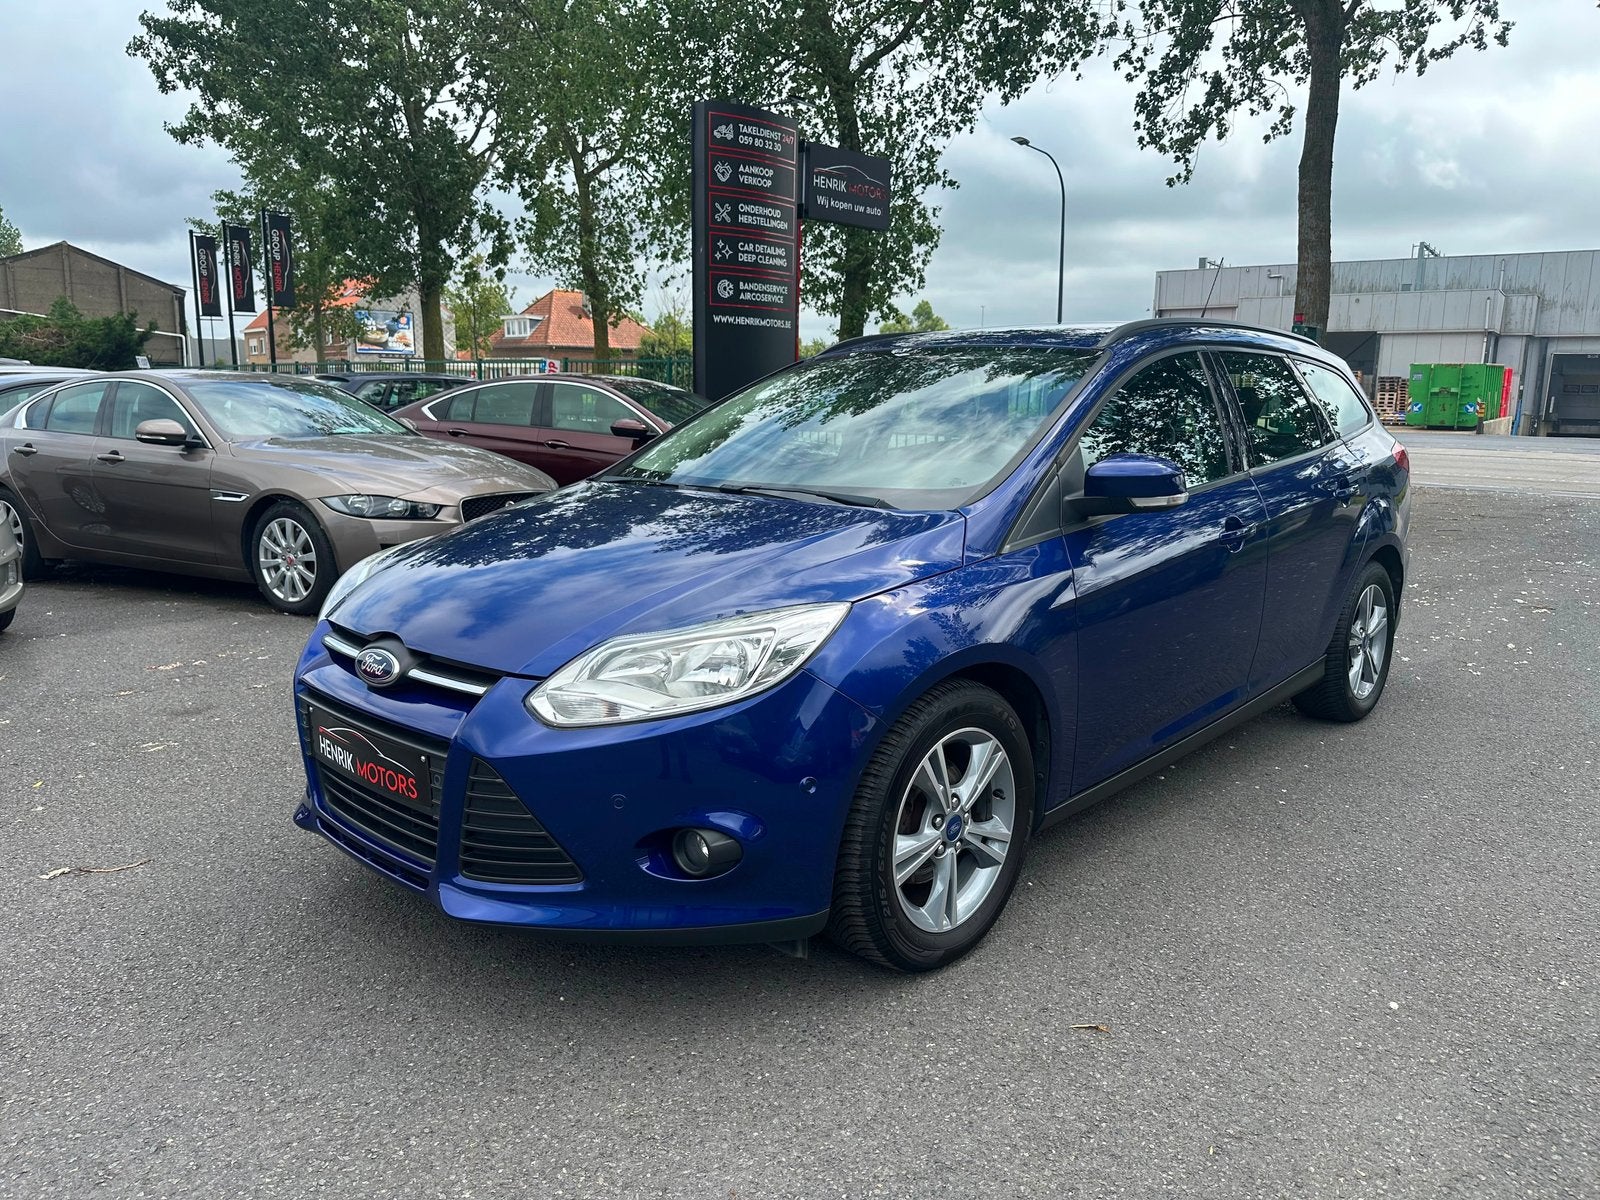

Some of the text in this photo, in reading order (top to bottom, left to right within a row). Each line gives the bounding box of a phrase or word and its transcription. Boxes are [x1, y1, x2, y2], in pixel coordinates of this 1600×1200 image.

[738, 123, 794, 145] TAKELDIENST 24/7
[738, 135, 782, 152] 059 80 32 30
[738, 163, 774, 178] AANKOOP
[738, 175, 772, 188] VERKOOP
[813, 174, 847, 193] HENRIK
[738, 203, 781, 219] ONDERHOUD
[816, 195, 882, 216] Wij kopen uw auto
[738, 214, 788, 230] HERSTELLINGEN
[271, 229, 281, 261] GROUP
[738, 241, 786, 256] CAR DETAILING
[232, 240, 241, 267] HENRIK
[738, 253, 788, 268] DEEP CLEANING
[199, 248, 208, 276] GROUP
[739, 281, 788, 295] BANDENSERVICE
[739, 292, 784, 304] AIRCOSERVICE
[713, 314, 792, 329] WWW.HENRIKMOTORS.BE
[361, 652, 386, 676] Ford
[319, 735, 418, 799] HENRIK MOTORS
